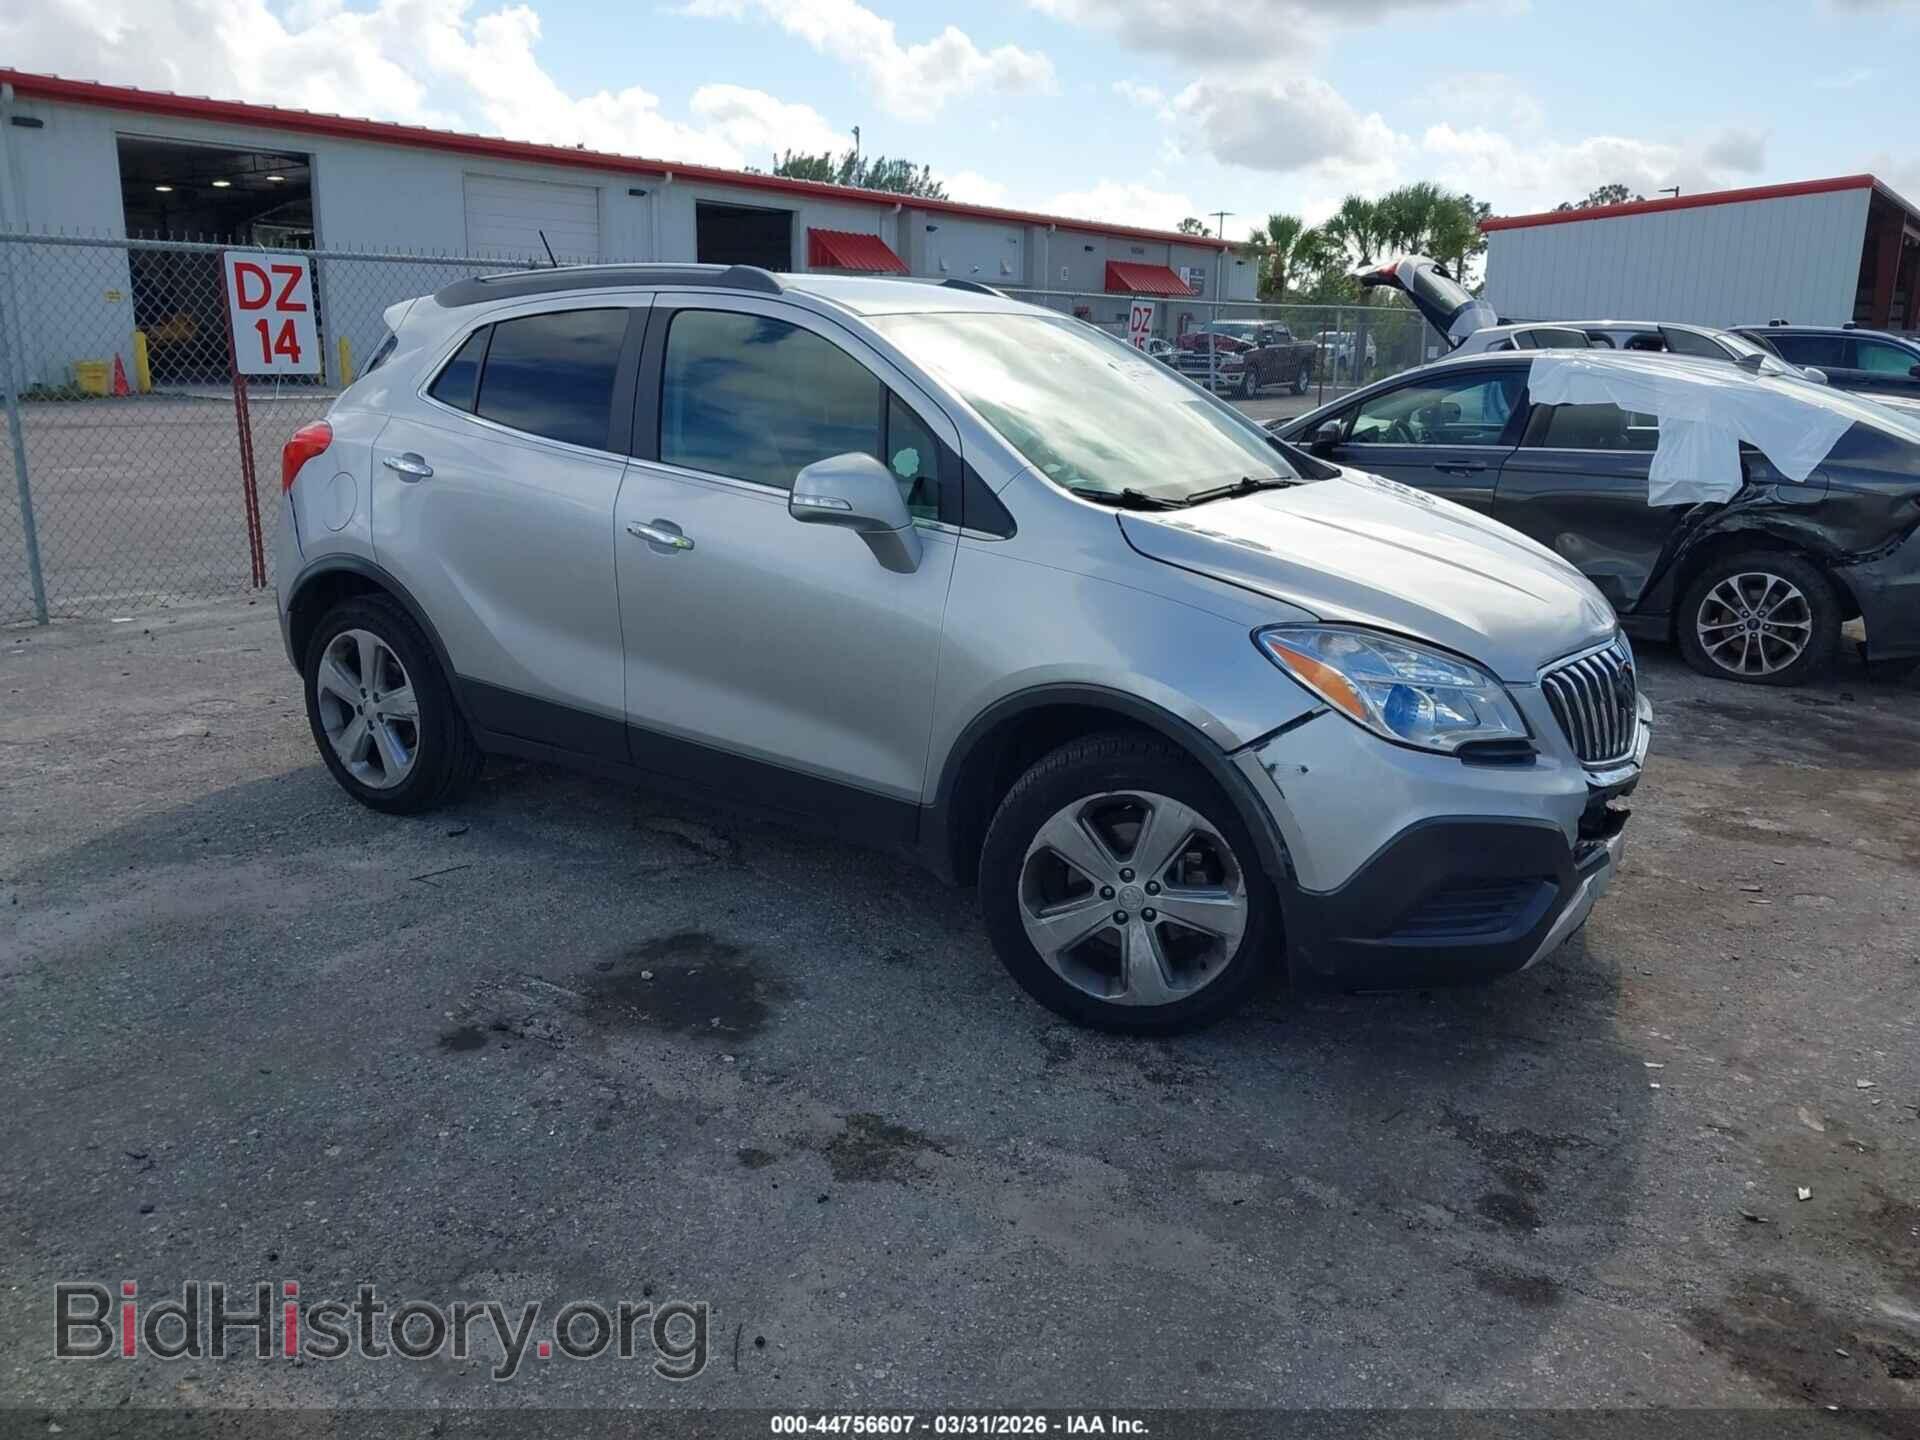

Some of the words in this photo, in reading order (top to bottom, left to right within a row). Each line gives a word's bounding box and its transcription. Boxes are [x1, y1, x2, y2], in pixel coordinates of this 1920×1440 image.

[234, 262, 307, 312] DZ
[255, 319, 301, 364] 14
[1131, 307, 1152, 332] DZ
